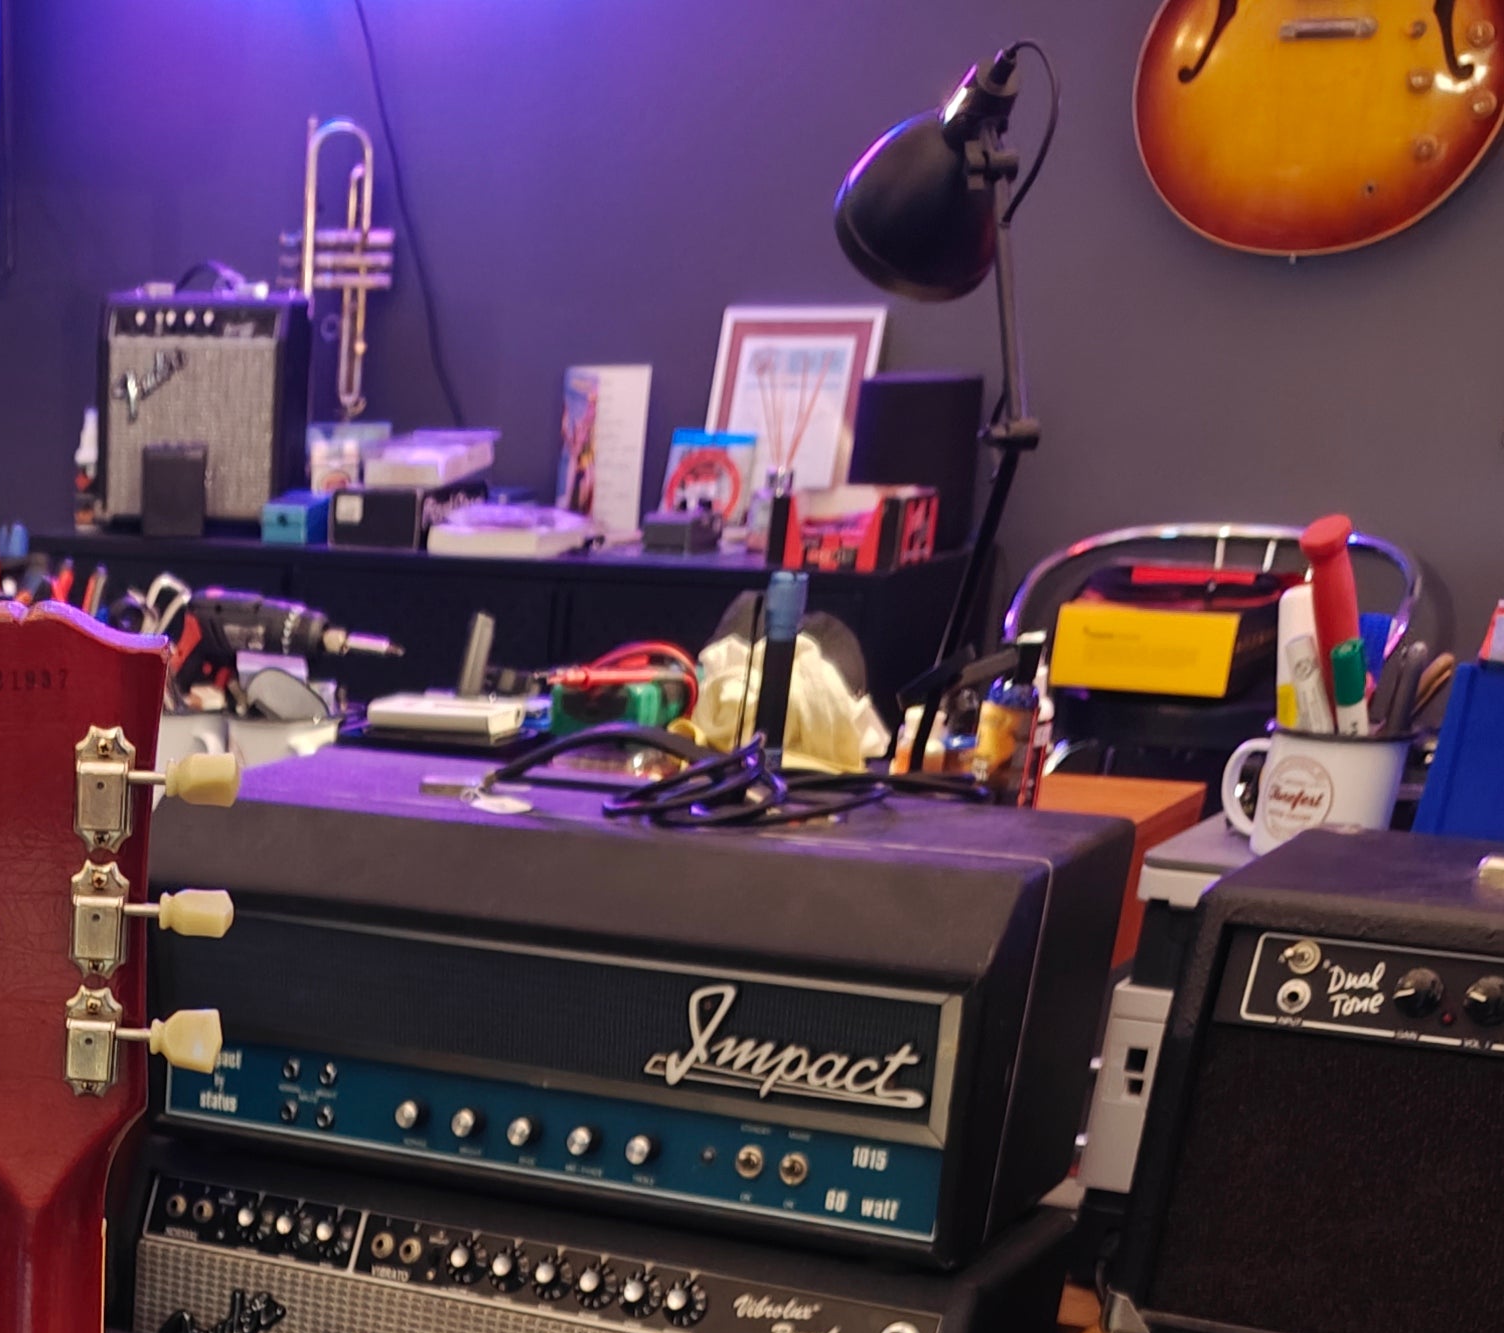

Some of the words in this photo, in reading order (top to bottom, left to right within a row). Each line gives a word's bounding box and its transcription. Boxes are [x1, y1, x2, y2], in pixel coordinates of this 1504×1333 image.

[1325, 960, 1386, 995] Dual
[1327, 991, 1385, 1018] Tone
[644, 983, 927, 1110] Impact
[198, 1089, 239, 1114] status
[851, 1145, 889, 1172] 1015
[860, 1196, 901, 1222] watt
[369, 1262, 411, 1284] VIBRATO
[732, 1292, 823, 1322] Vibrolux
